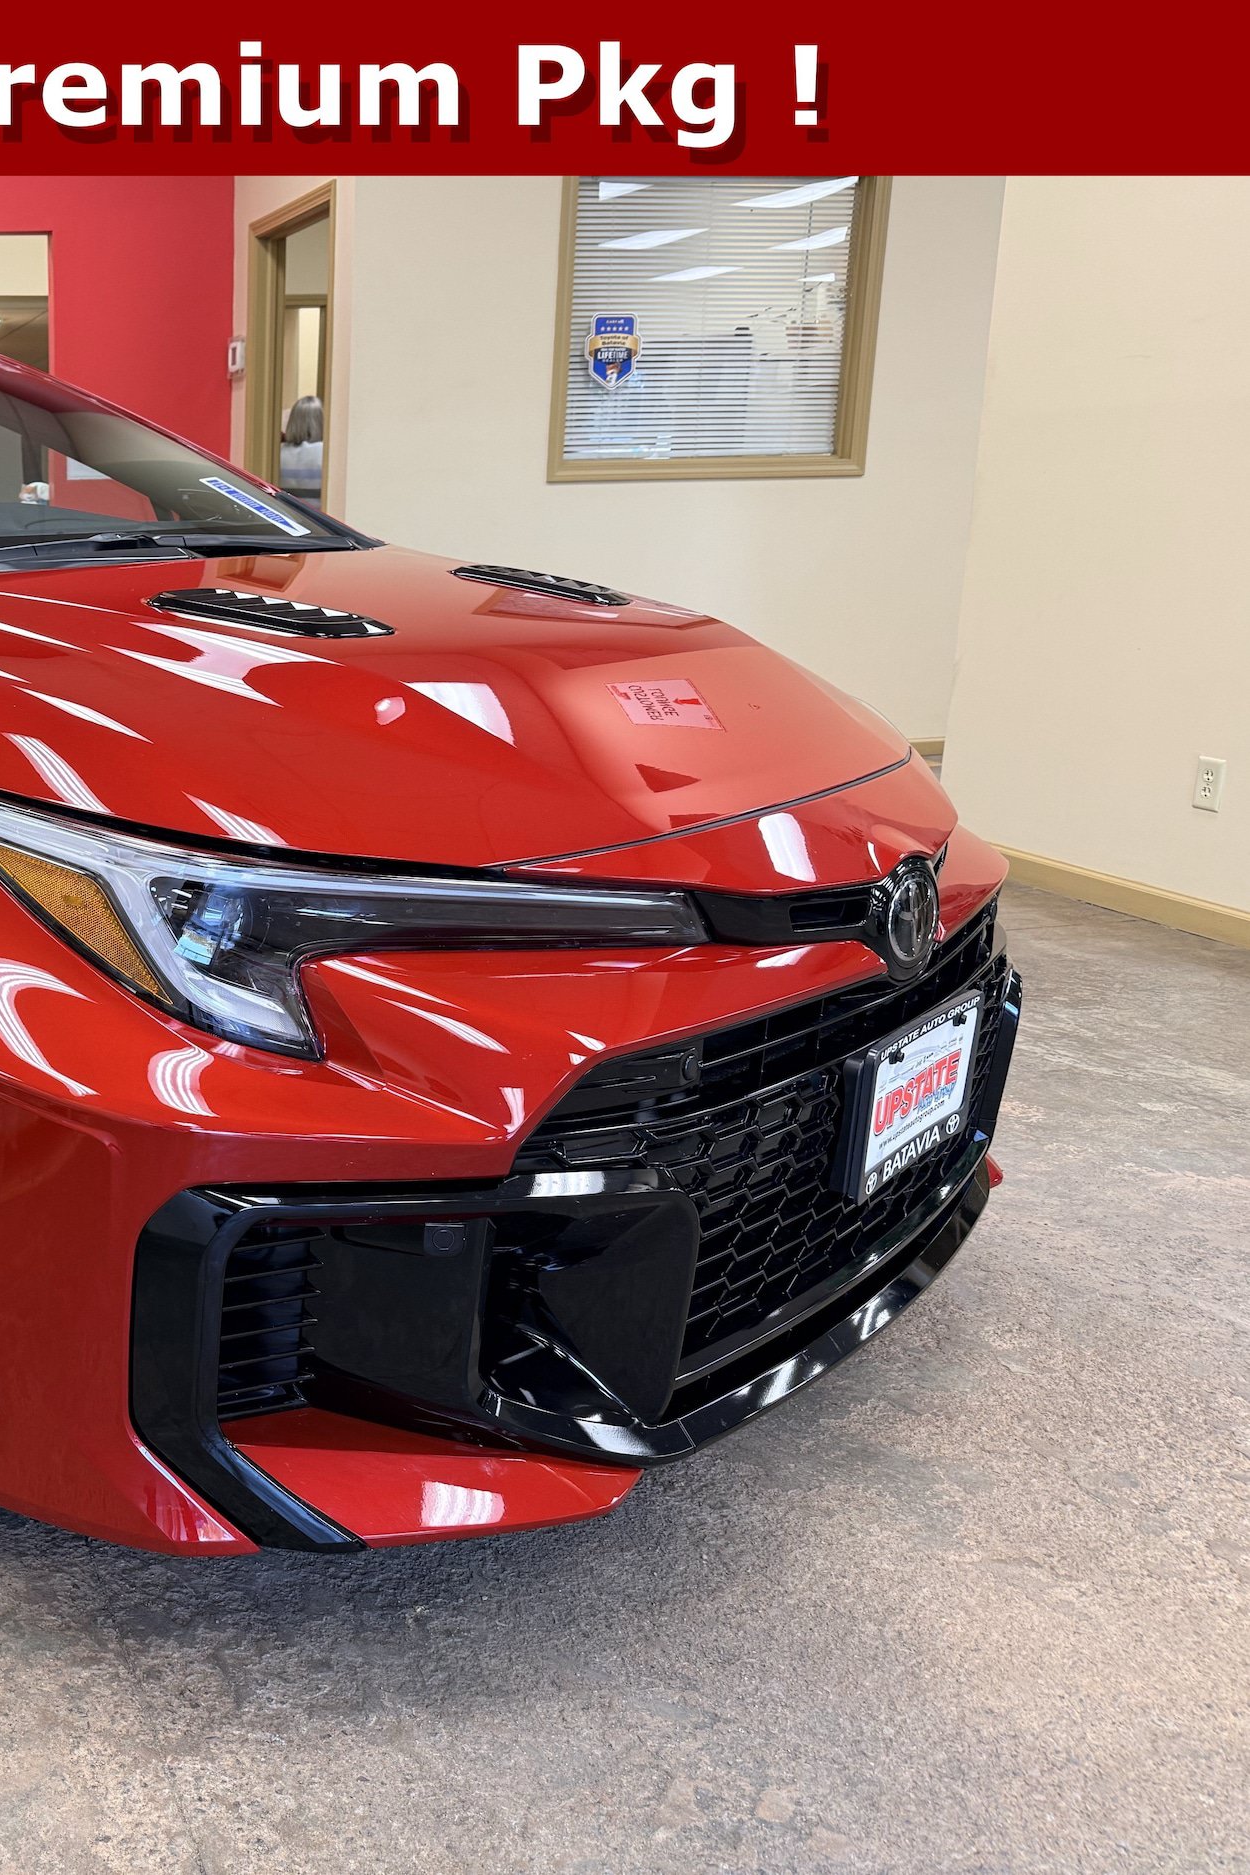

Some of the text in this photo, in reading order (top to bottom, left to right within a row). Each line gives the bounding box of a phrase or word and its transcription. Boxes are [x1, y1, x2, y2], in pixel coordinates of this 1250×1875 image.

[597, 351, 628, 360] LIFETIME
[881, 996, 980, 1061] UPSTATE AUTO GROUP
[873, 1048, 962, 1136] UPSTATE
[878, 1099, 945, 1150] www.upstateautogroup.com
[882, 1125, 940, 1182] BATAVIA
